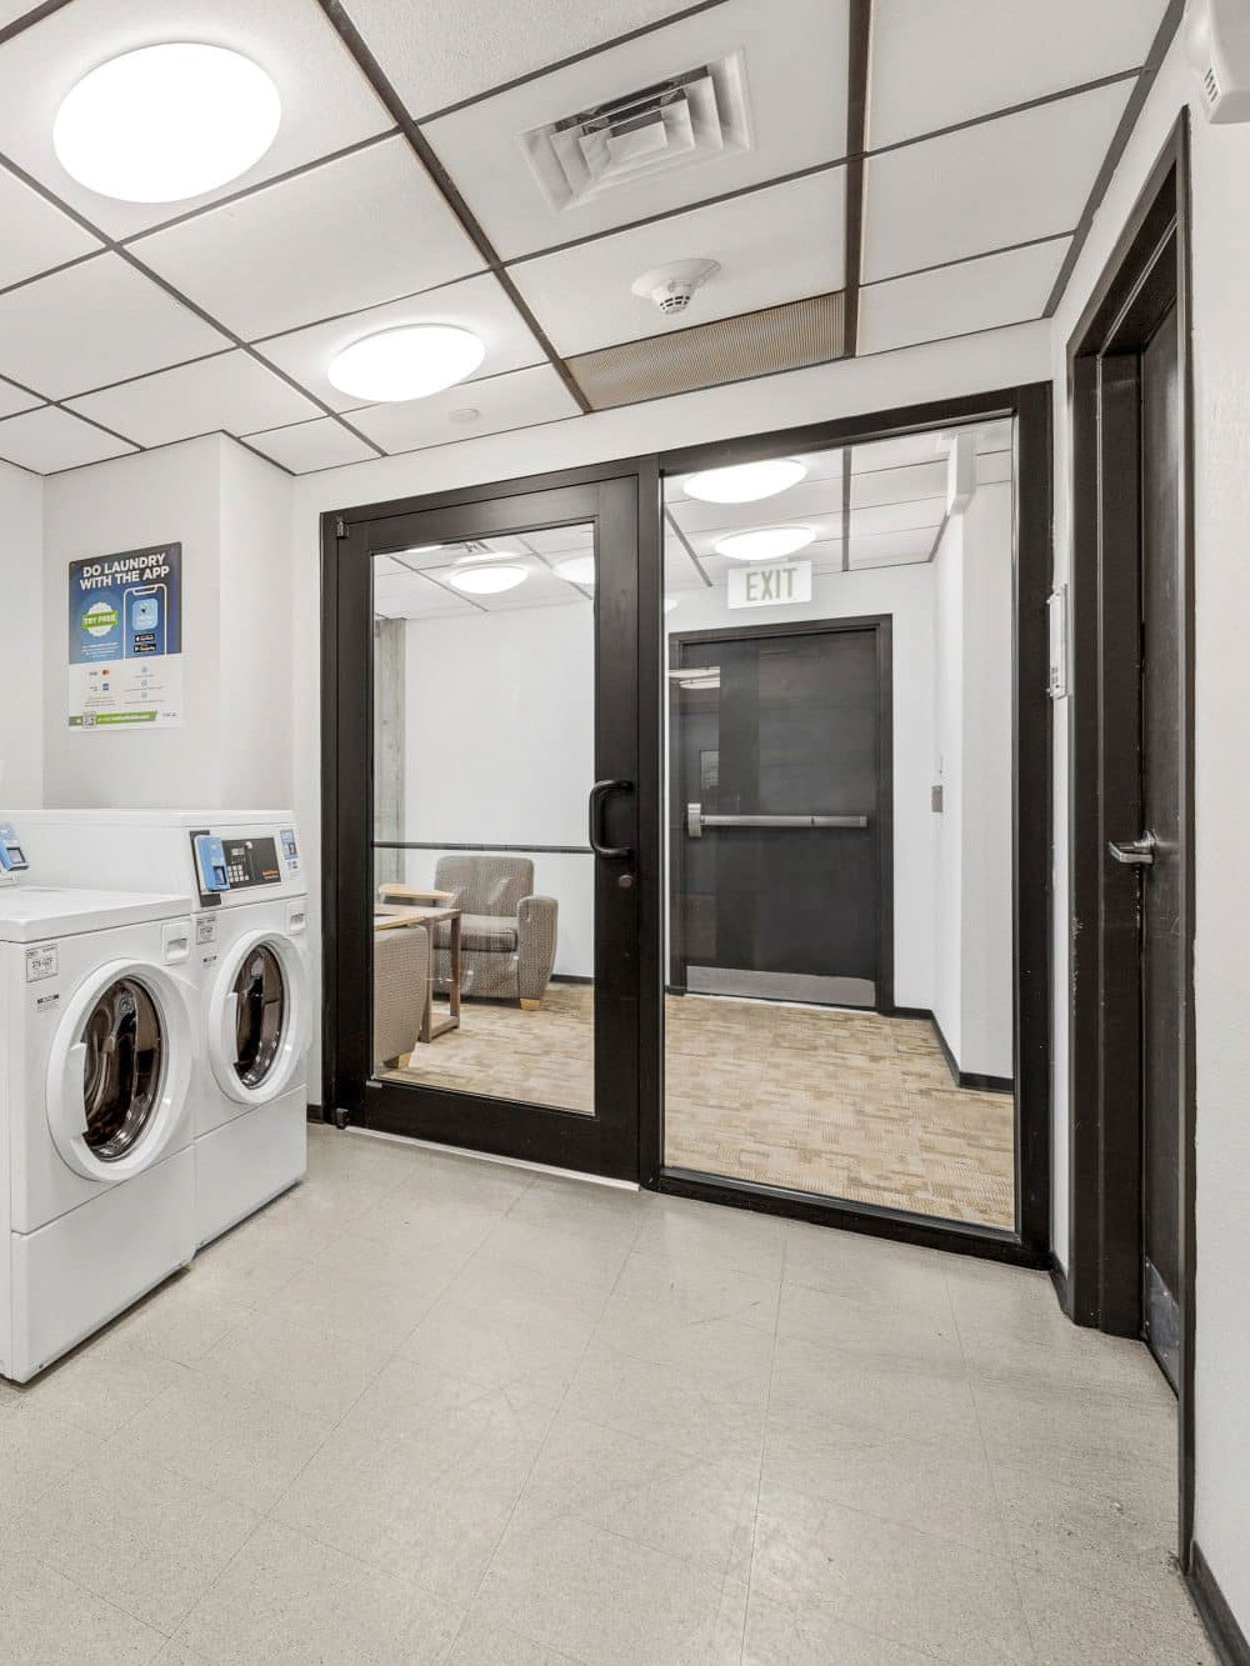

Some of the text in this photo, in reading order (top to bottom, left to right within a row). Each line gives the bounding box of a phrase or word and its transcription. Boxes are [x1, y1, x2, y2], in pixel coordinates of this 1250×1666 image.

[80, 565, 170, 590] WITH THE APP
[83, 553, 166, 578] DO LAUNDRY
[746, 567, 798, 601] EXIT
